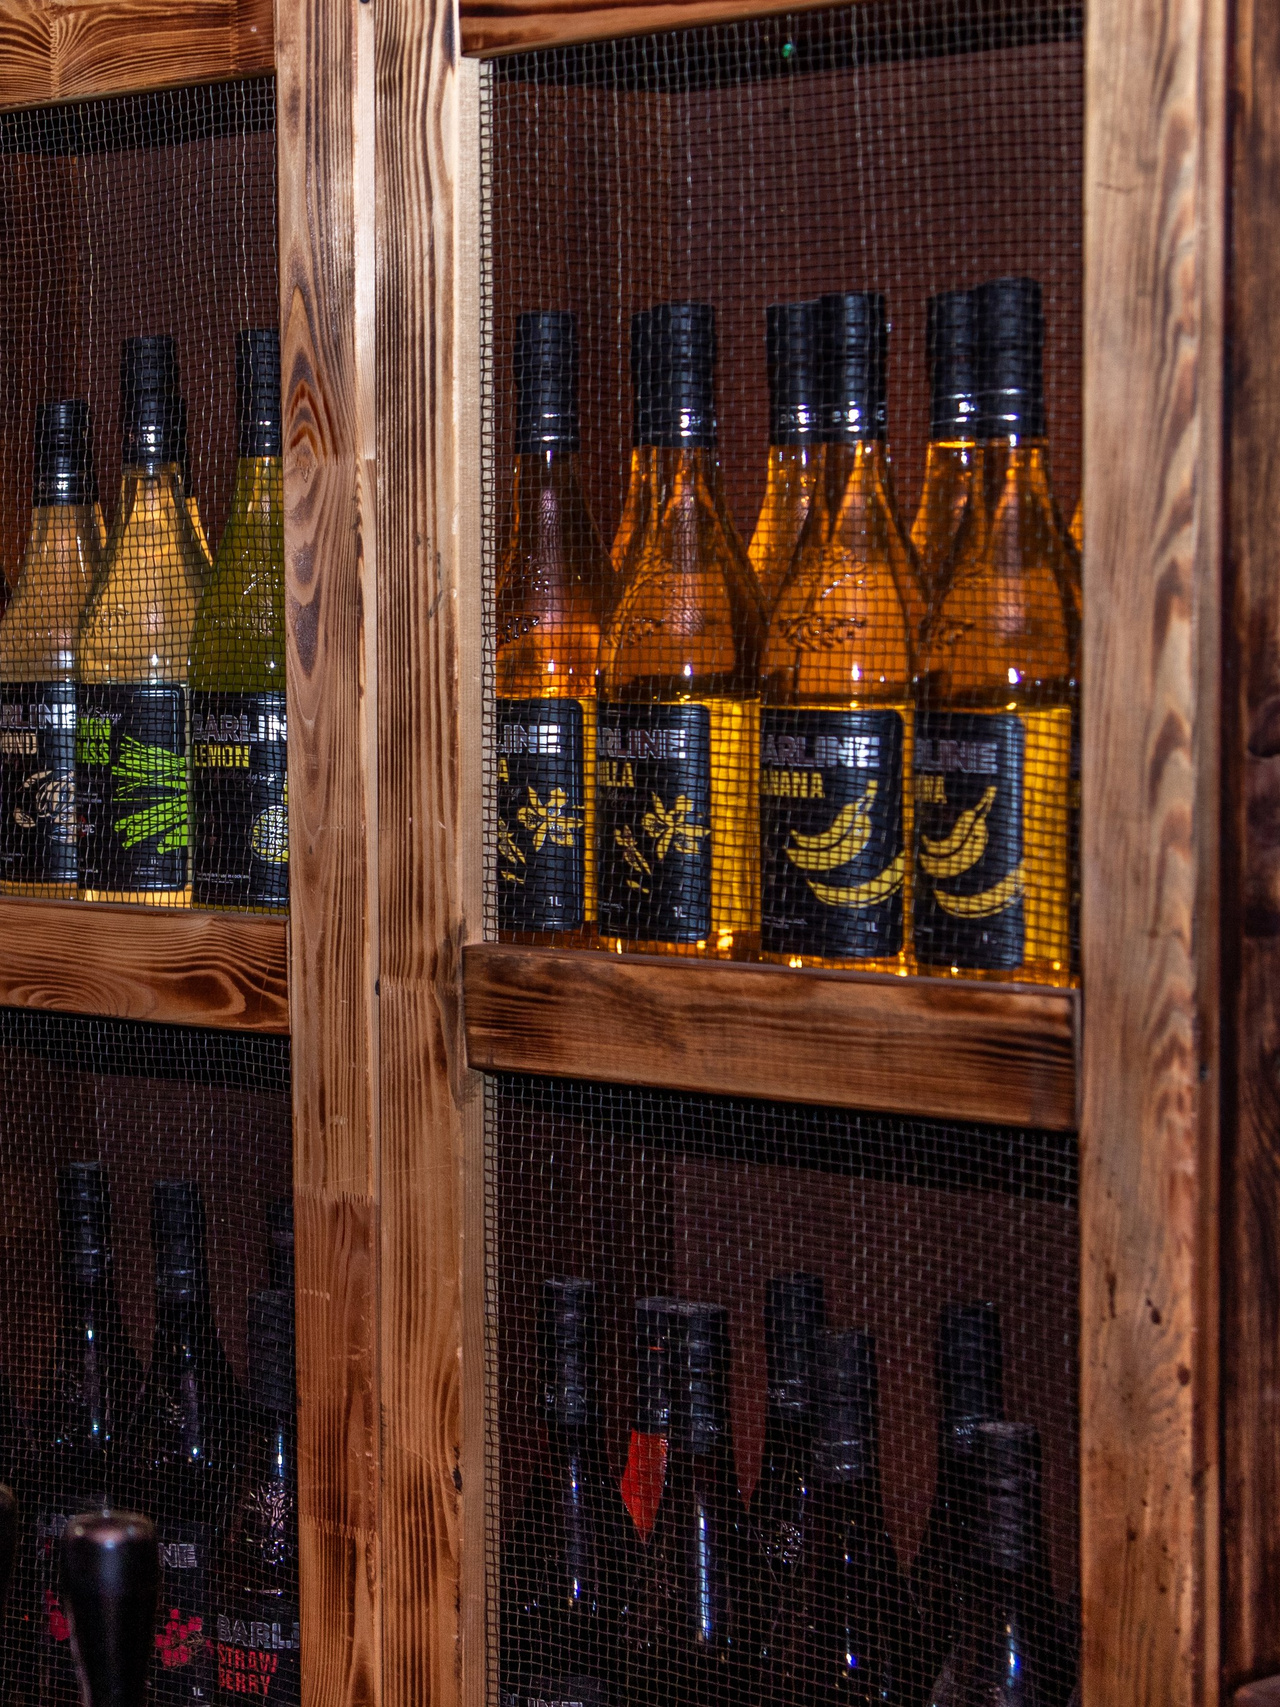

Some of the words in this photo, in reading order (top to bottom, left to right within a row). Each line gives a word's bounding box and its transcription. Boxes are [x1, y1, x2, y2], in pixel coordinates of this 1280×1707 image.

[0, 703, 77, 729] RLINE
[194, 713, 288, 742] BARLIN
[194, 744, 251, 767] LEMON
[761, 733, 880, 768] ARLINE
[549, 896, 562, 908] 1L
[216, 1614, 300, 1650] BARLI
[217, 1643, 279, 1674] STRAW
[191, 1686, 205, 1697] 1L
[218, 1667, 274, 1696] BERRY
